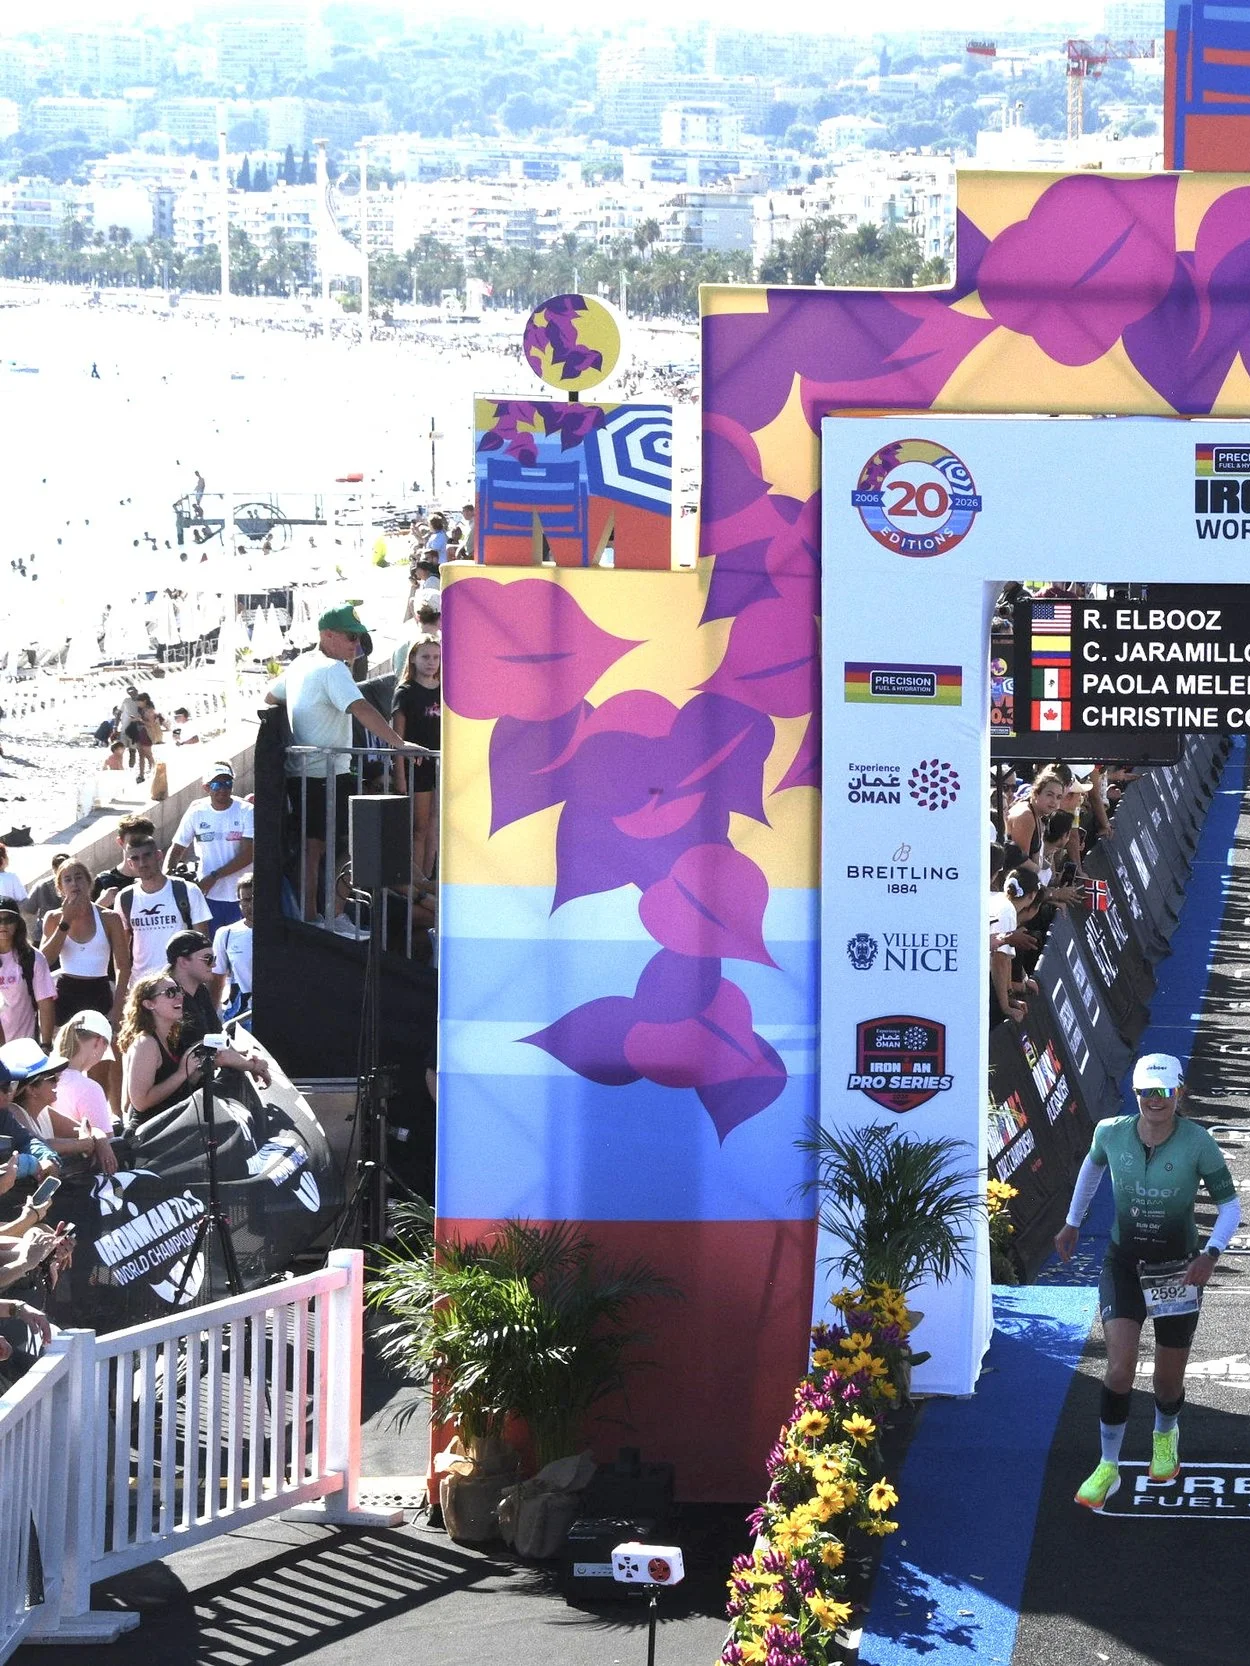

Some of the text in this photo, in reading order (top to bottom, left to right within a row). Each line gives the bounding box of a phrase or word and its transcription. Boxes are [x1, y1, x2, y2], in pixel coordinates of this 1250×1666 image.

[855, 493, 879, 502] 2006
[886, 481, 949, 518] 20
[955, 498, 979, 507] 2026
[880, 526, 954, 550] EDITIONS
[1083, 609, 1107, 630] R.
[1116, 610, 1222, 630] ELBOOZ
[1082, 642, 1107, 663] C.
[875, 676, 931, 686] PRECISION
[1083, 674, 1169, 695] PAOLA
[1082, 706, 1219, 728] CHRISTINE
[848, 763, 901, 774] Experience
[848, 790, 901, 804] OMAN
[847, 866, 959, 880] BREITLING
[887, 884, 918, 894] 1884
[882, 932, 959, 948] VILLE DE
[883, 948, 959, 972] NICE
[849, 1076, 952, 1090] PRO SERIES
[94, 1190, 205, 1268] IRONMAN 70.3
[113, 1255, 150, 1286] WORLD
[1151, 1287, 1187, 1301] 2592
[1133, 1496, 1236, 1508] FUEL
